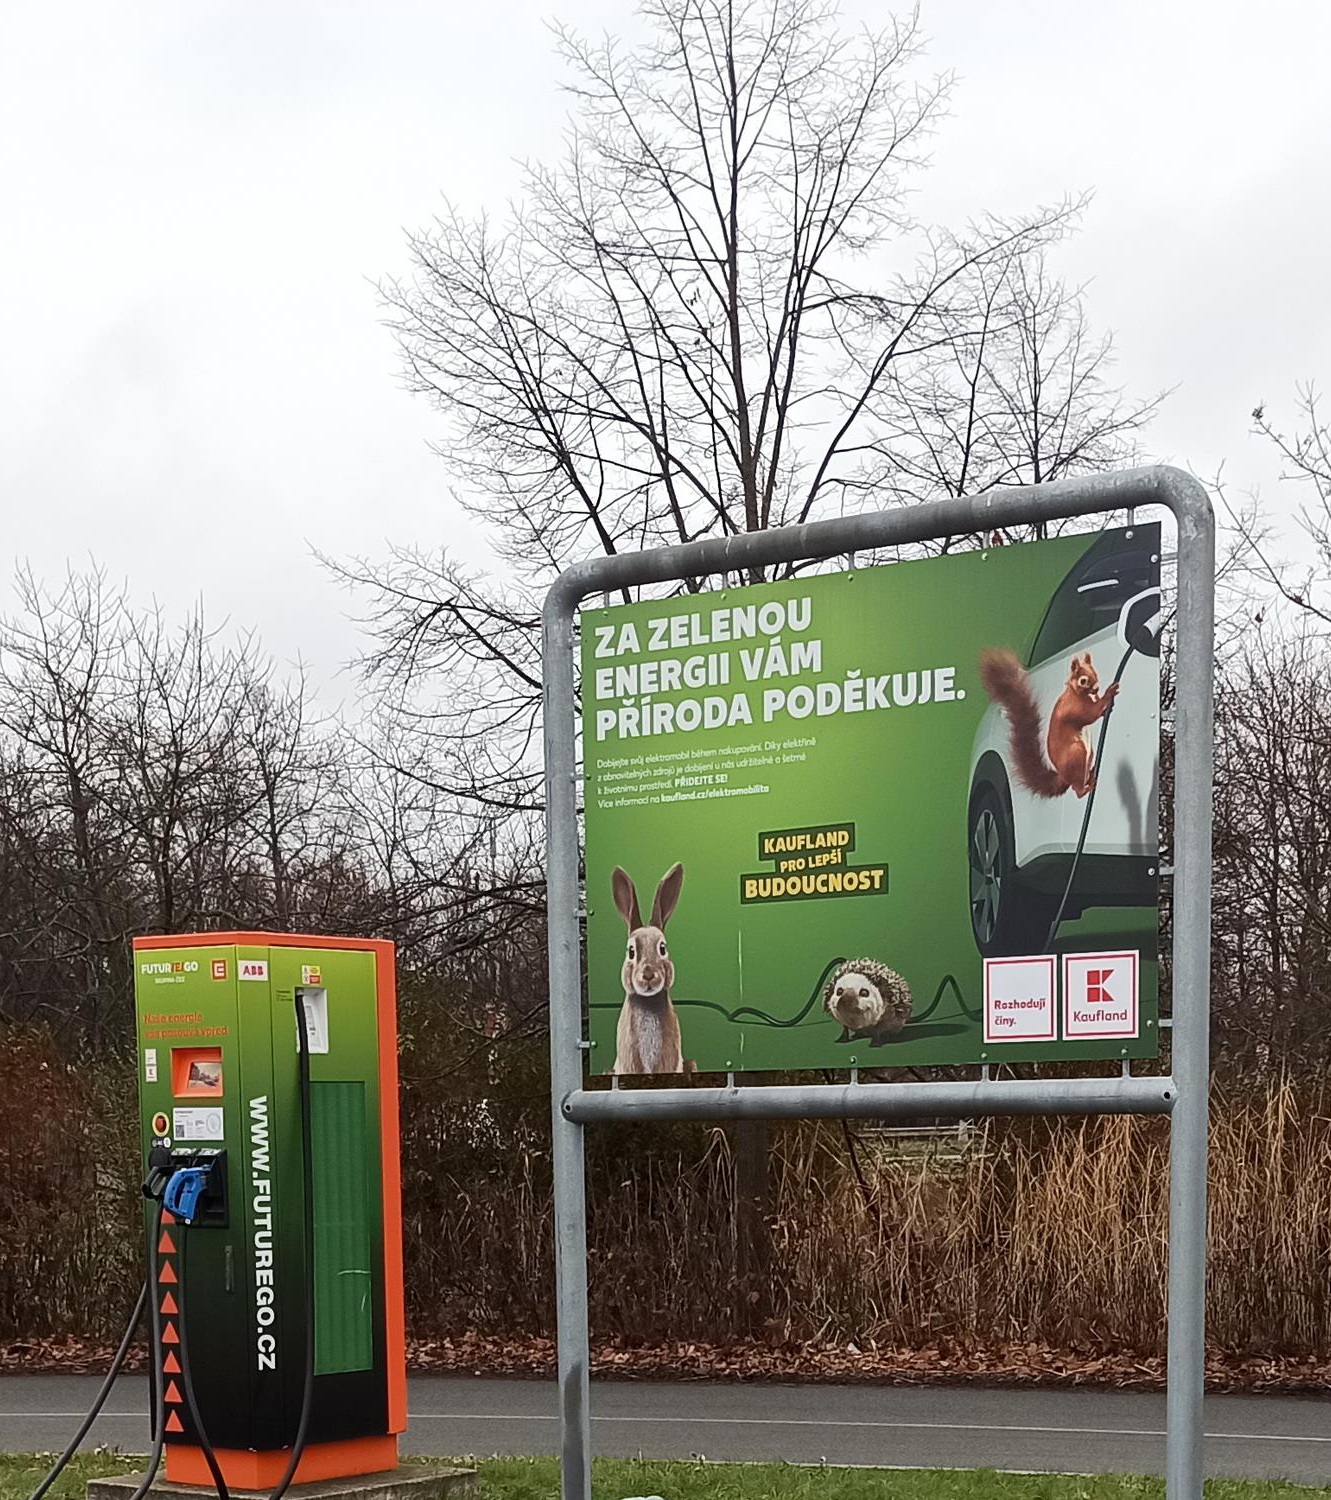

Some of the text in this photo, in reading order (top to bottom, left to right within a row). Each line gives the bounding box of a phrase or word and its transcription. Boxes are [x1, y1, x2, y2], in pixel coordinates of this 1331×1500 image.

[594, 596, 812, 658] ZA ZELENOU
[595, 636, 822, 700] ENERGII VÁM
[596, 666, 966, 742] PŘÍRODA PODĚKUJE.
[645, 750, 690, 763] elektromobil
[597, 787, 602, 795] k
[674, 775, 714, 787] PŘIDEJTE
[715, 774, 728, 783] SE!
[764, 830, 849, 853] KAUFLAND
[780, 849, 842, 873] PRO LEPŠÍ
[745, 869, 884, 899] BUDOUCNOST
[243, 965, 264, 976] ABB
[994, 998, 1046, 1010] Rozhodují
[1073, 1009, 1128, 1022] Kaufland
[994, 1015, 1017, 1028] činy.
[249, 1095, 276, 1371] WWW.FUTUREGO.CZ
